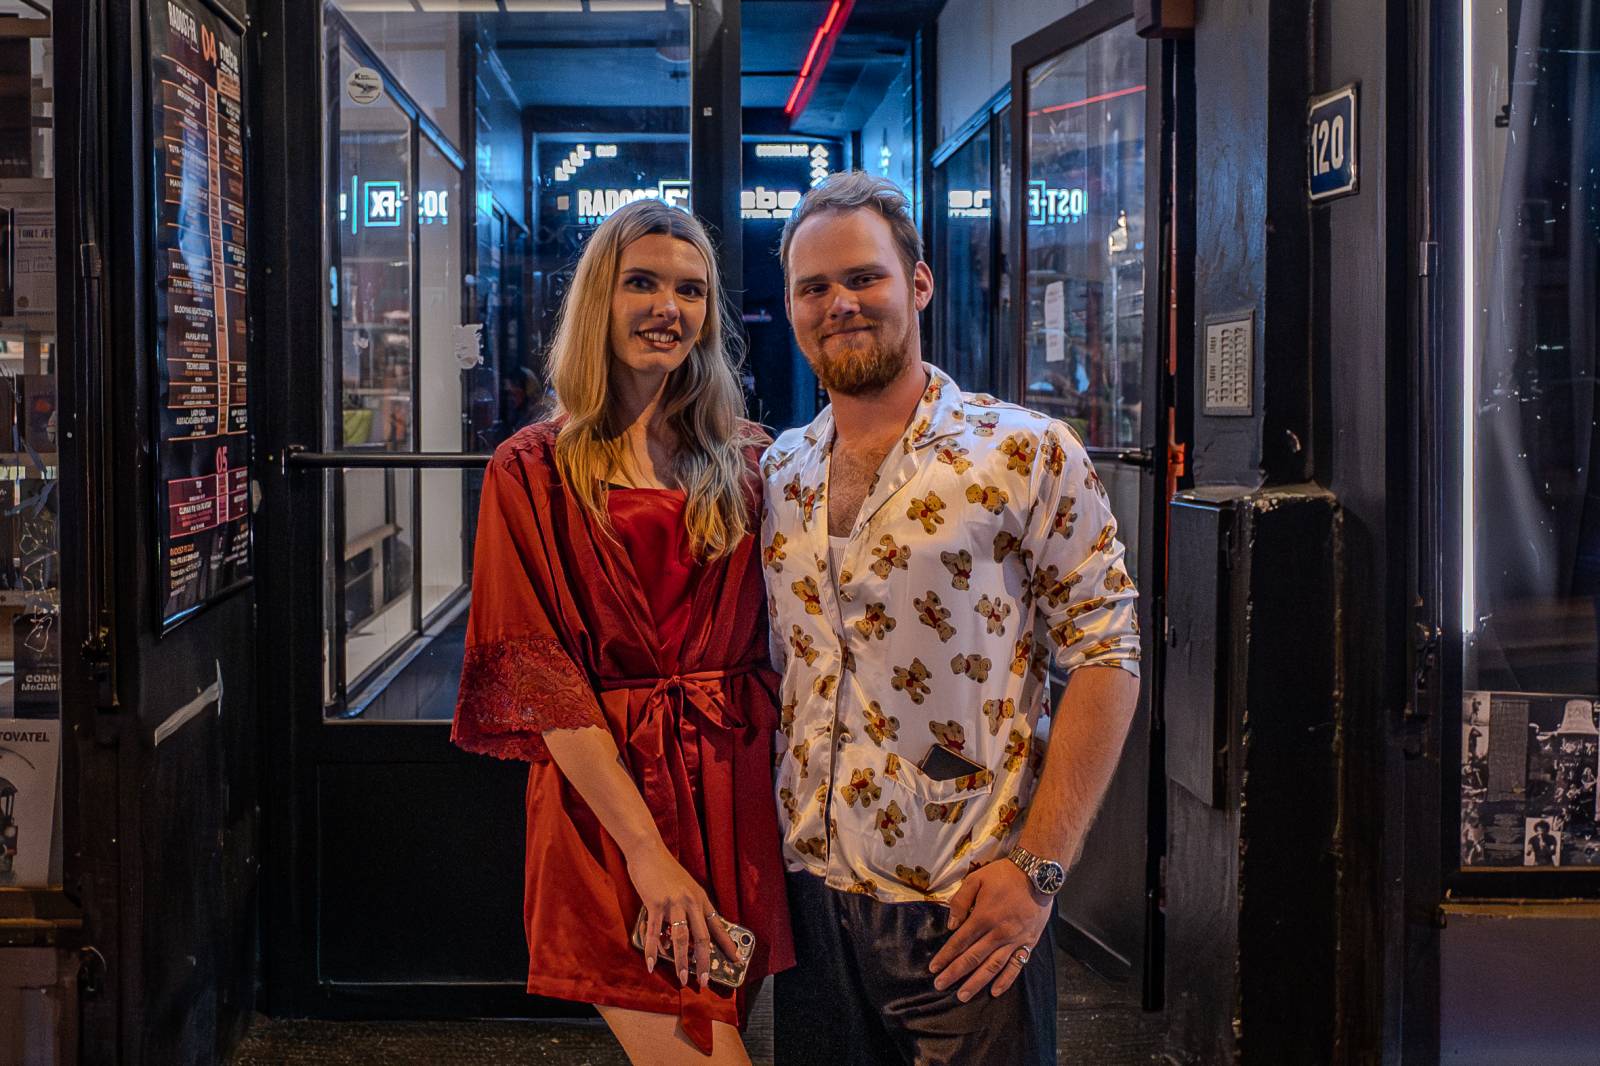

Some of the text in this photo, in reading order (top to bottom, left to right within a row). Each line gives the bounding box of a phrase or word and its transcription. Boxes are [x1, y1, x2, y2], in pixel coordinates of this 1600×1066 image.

[201, 24, 217, 66] 04
[1311, 115, 1344, 176] 120
[216, 446, 228, 474] 05
